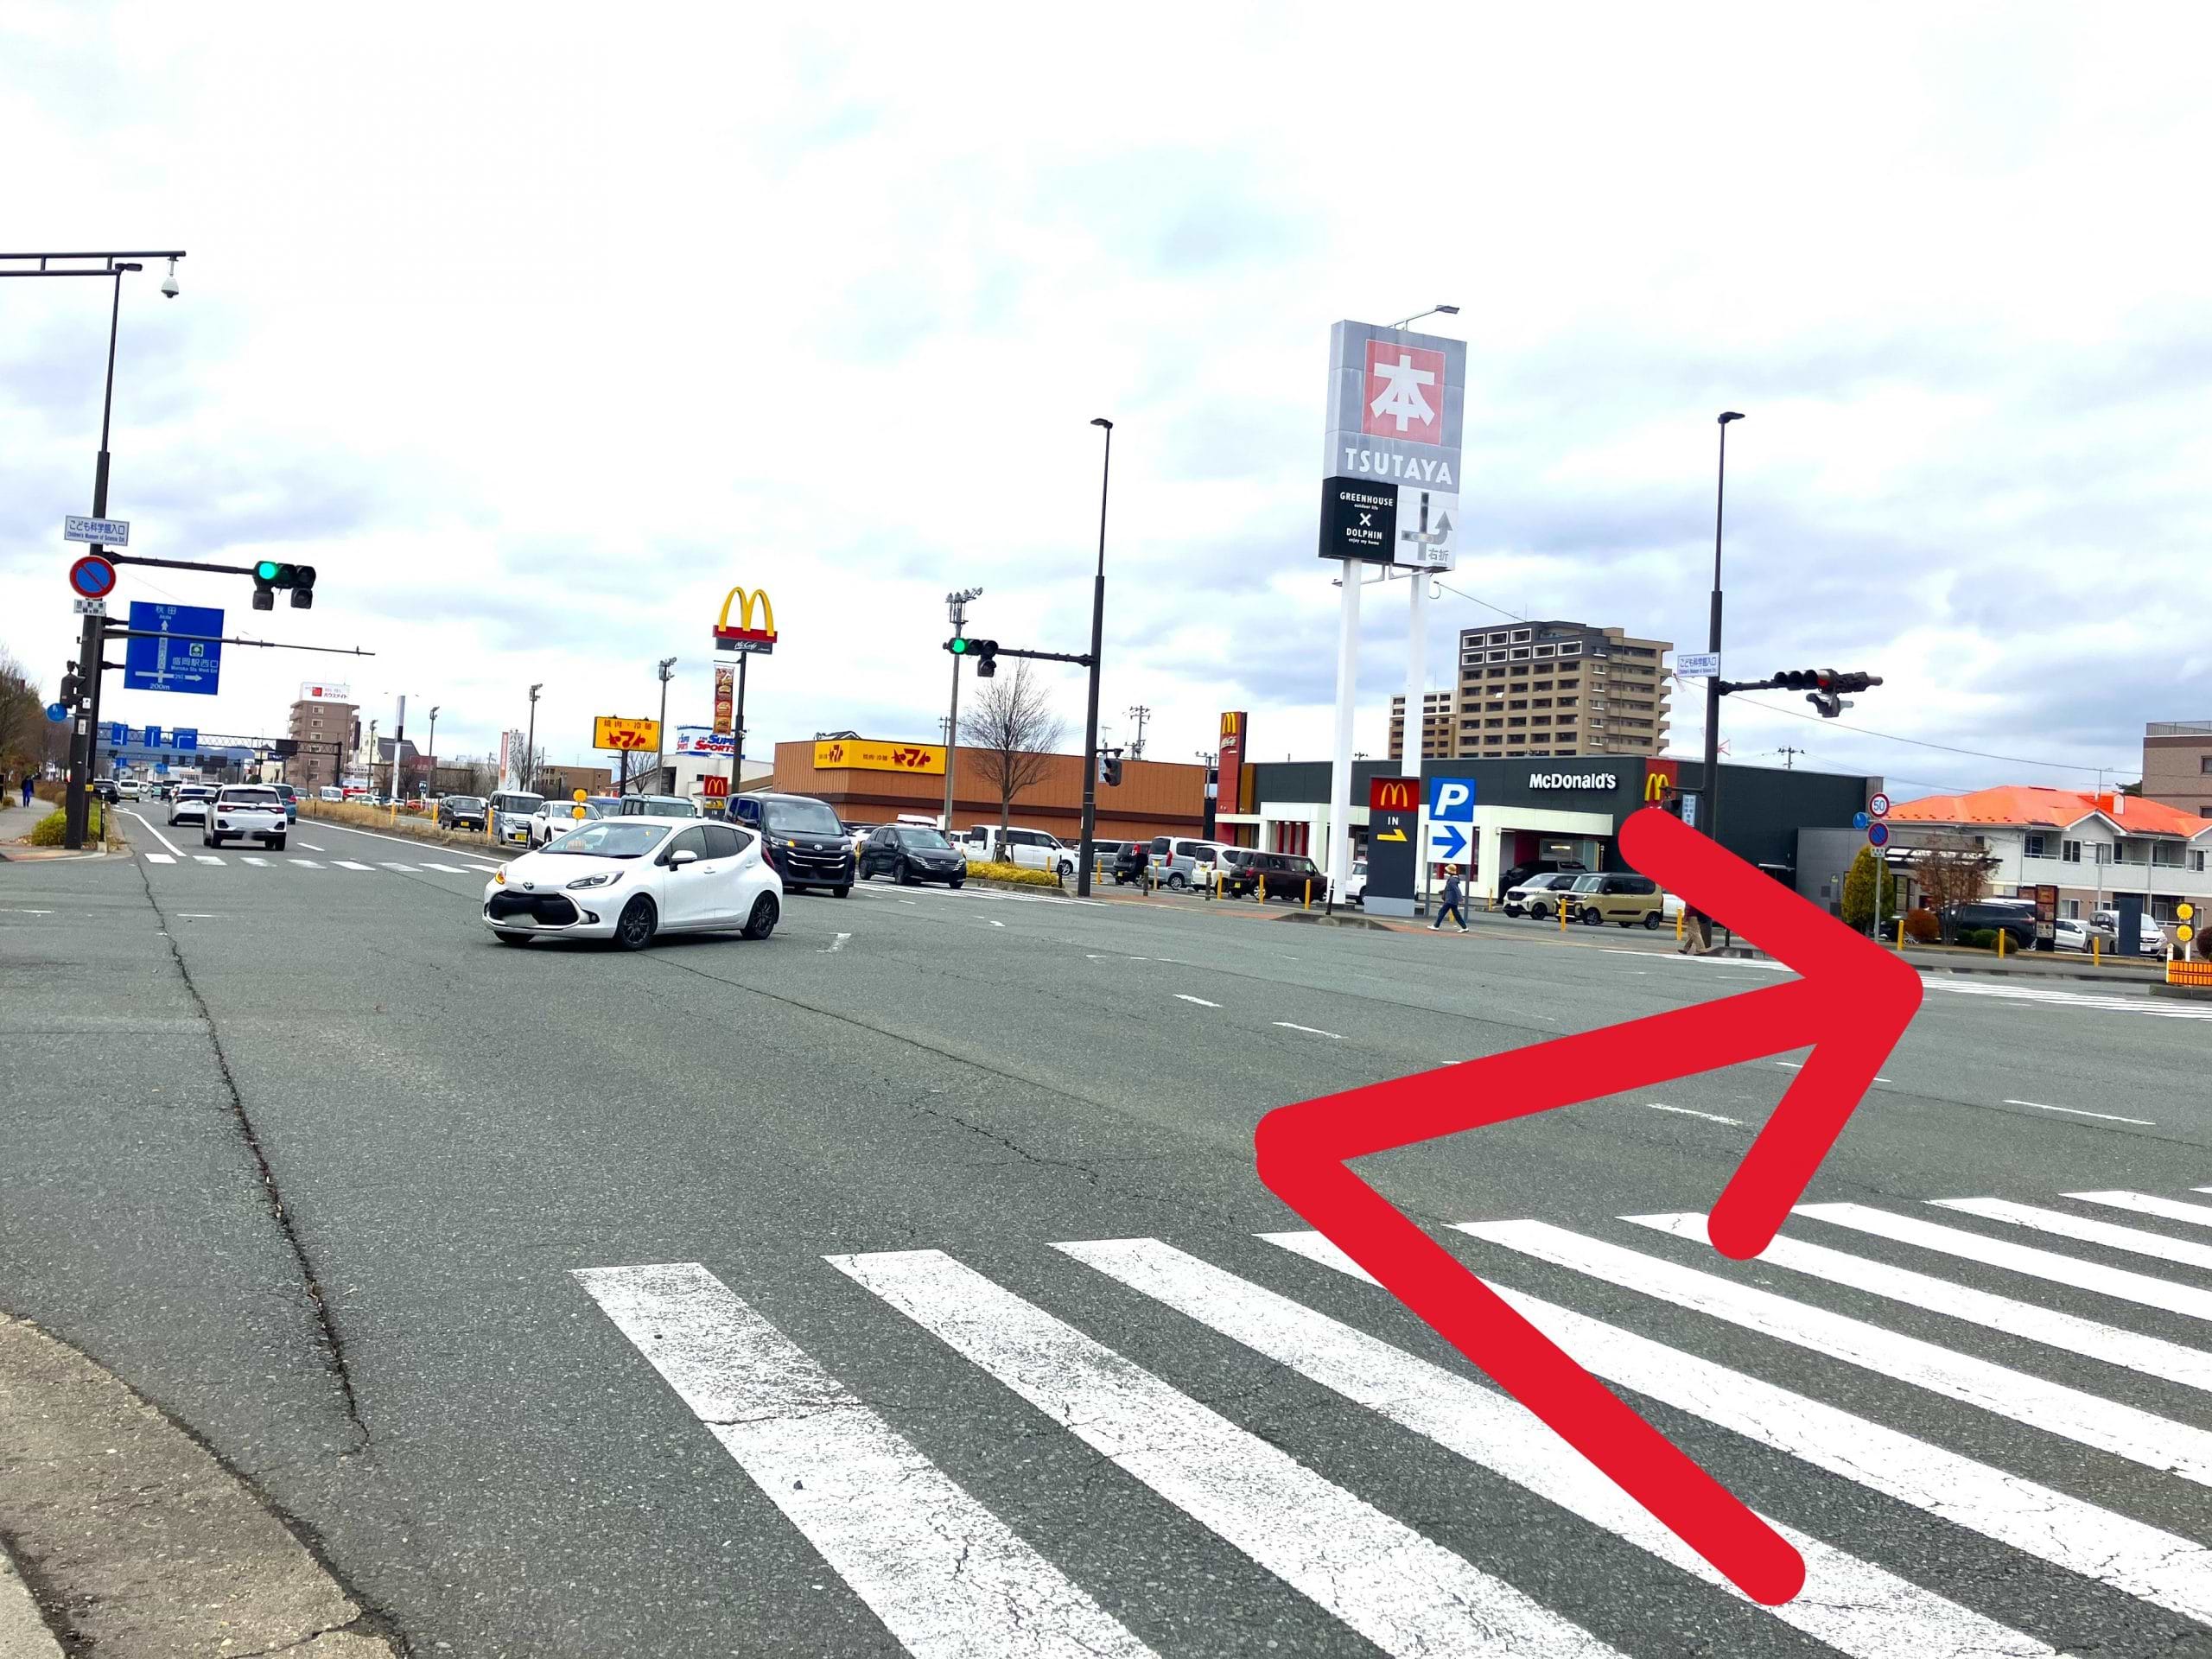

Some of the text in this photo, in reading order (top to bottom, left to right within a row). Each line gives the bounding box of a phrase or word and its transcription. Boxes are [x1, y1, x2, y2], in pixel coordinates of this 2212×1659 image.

[1370, 354, 1435, 432] 本
[1344, 448, 1452, 486] TSUTAYA
[1339, 491, 1394, 506] GREENHOUSE
[69, 520, 125, 535] こども科学館入口
[1346, 527, 1382, 540] DOLPHIN
[1427, 548, 1449, 563] 右折
[156, 606, 177, 615] 秋田
[1529, 773, 1617, 790] McDonald's
[1434, 783, 1469, 816] P
[1873, 800, 1885, 811] 50
[1387, 816, 1399, 826] IN
